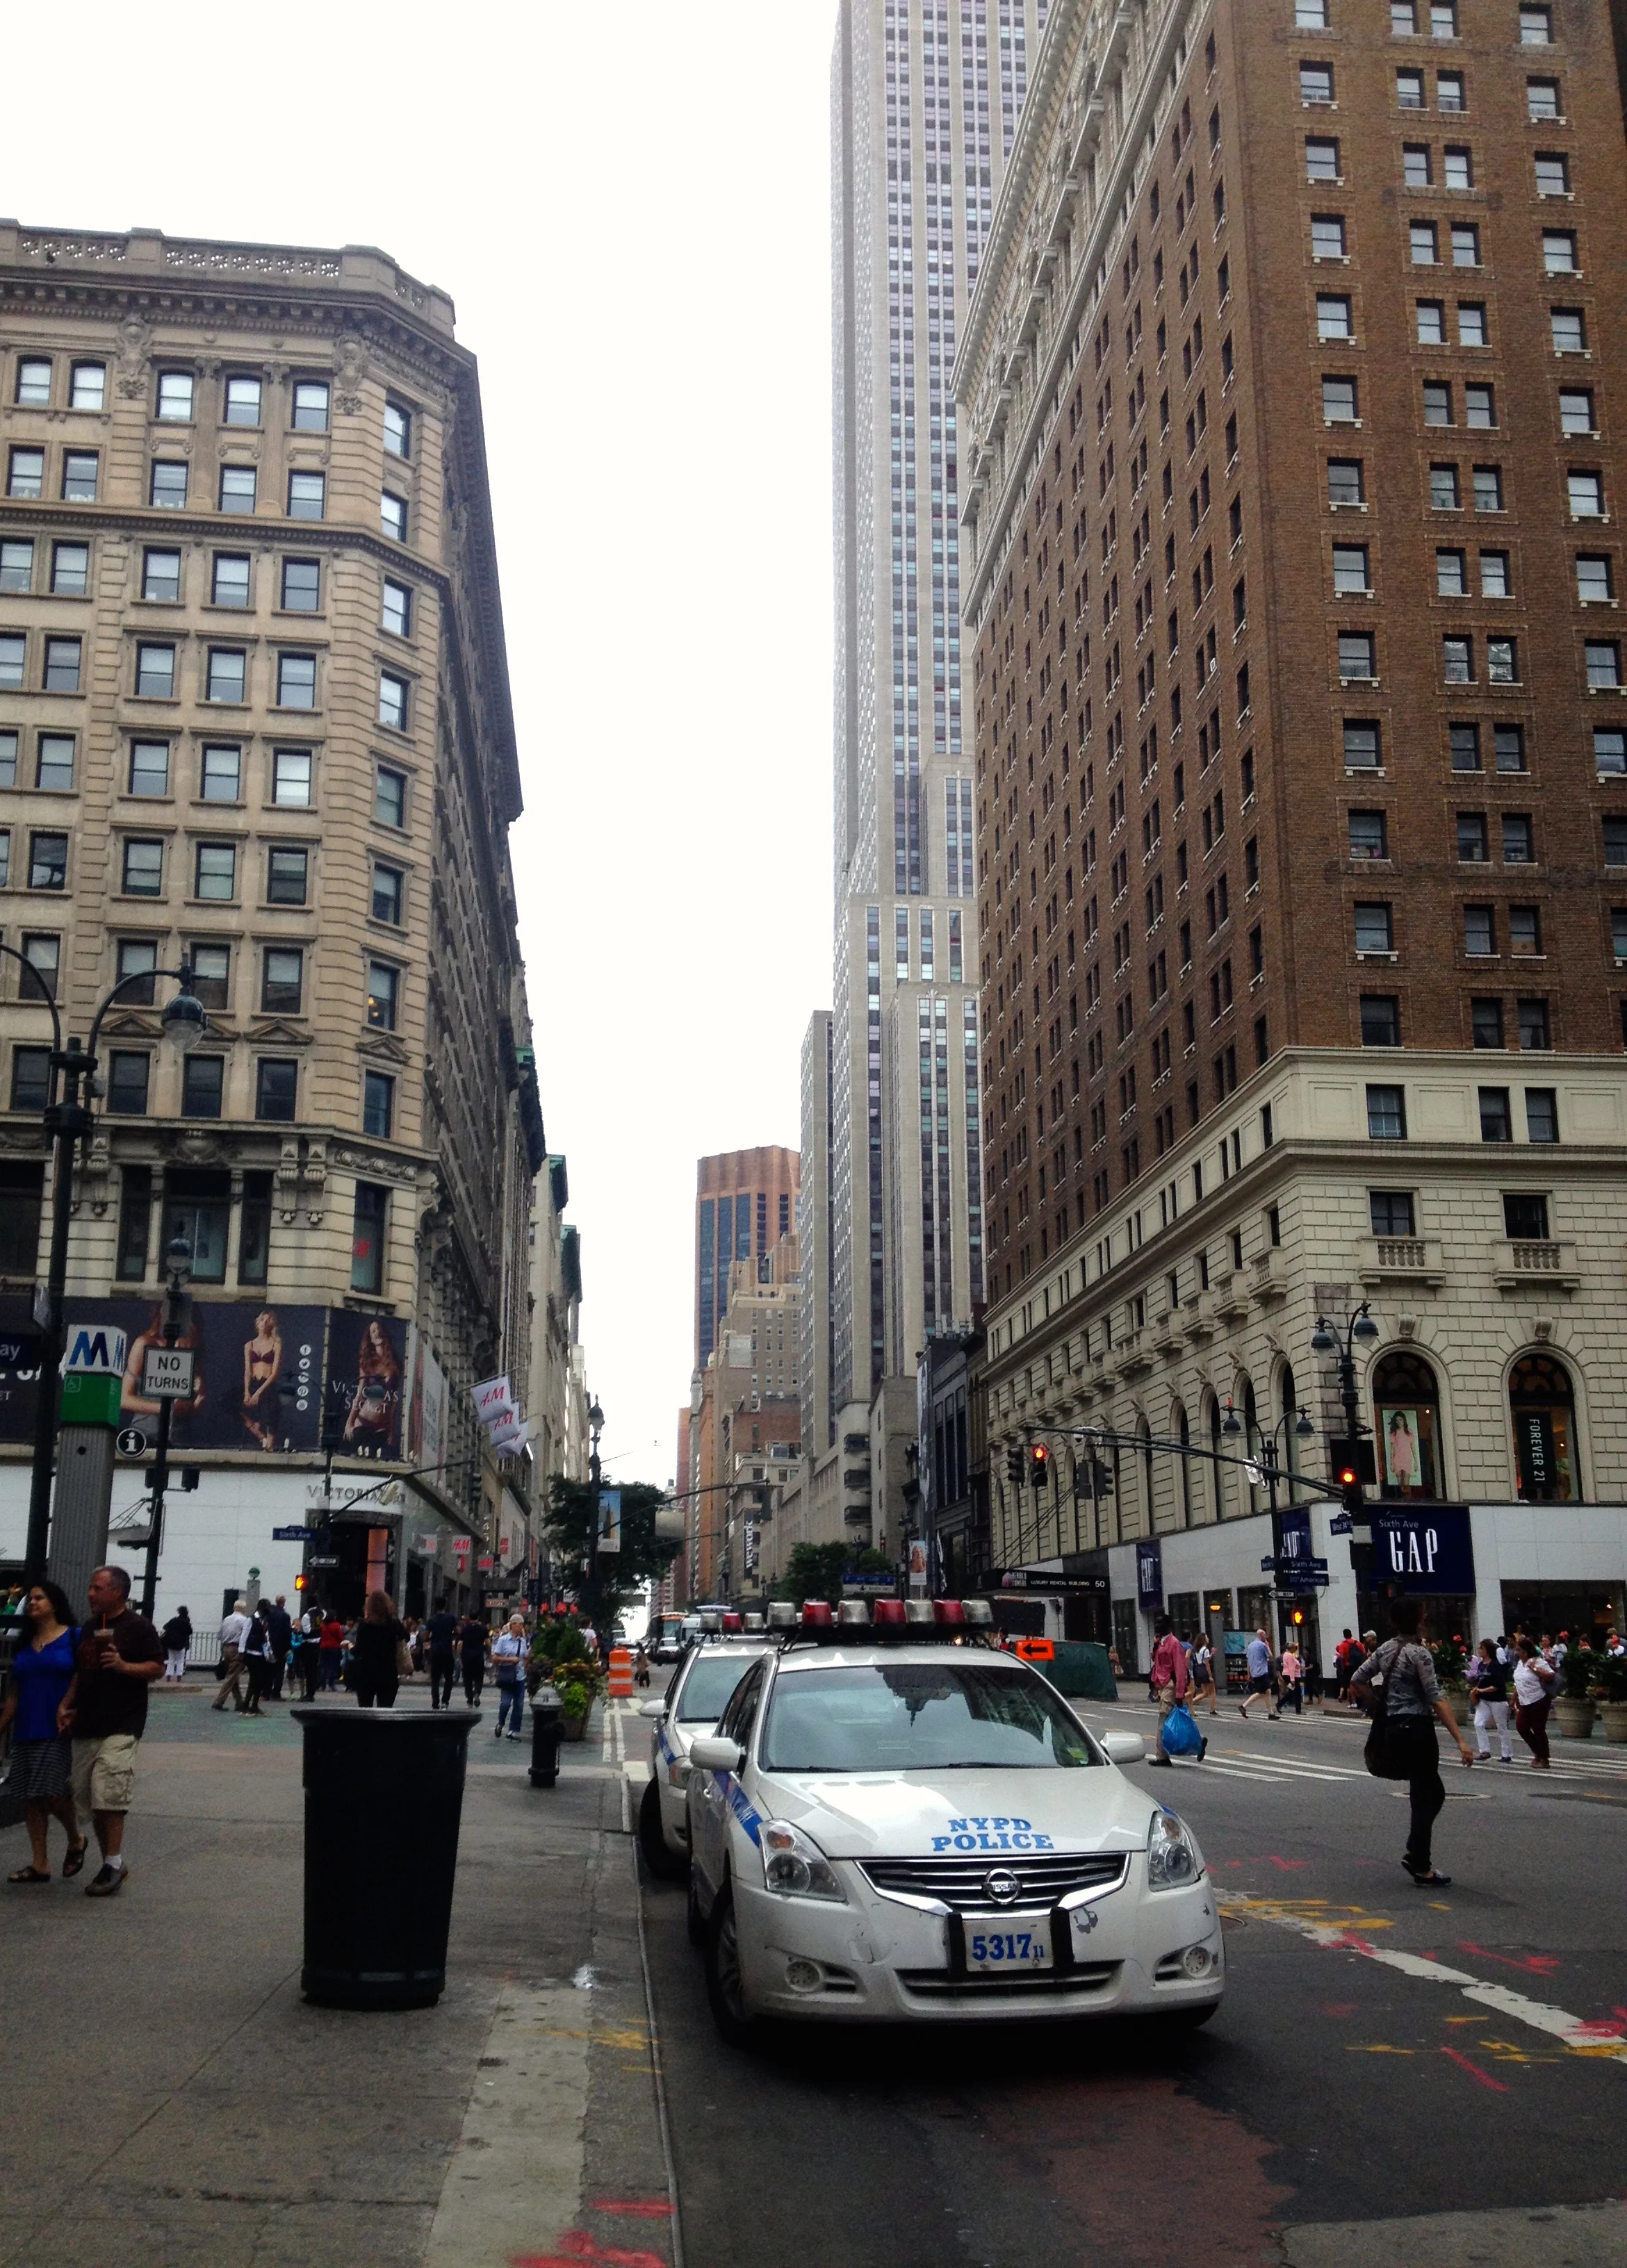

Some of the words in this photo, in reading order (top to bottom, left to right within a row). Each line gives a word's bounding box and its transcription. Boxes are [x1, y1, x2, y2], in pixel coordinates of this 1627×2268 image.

[158, 1356, 180, 1371] NO
[147, 1376, 188, 1389] TURNS
[1529, 1419, 1544, 1465] FOREVER
[1534, 1471, 1545, 1481] 21
[1379, 1519, 1400, 1528] Sixth
[1403, 1520, 1418, 1528] Ave
[744, 1520, 753, 1568] wework
[1390, 1529, 1438, 1572] GAP
[948, 1818, 1031, 1832] NYPD
[931, 1834, 1054, 1852] POLICE
[973, 1934, 1031, 1961] 5317
